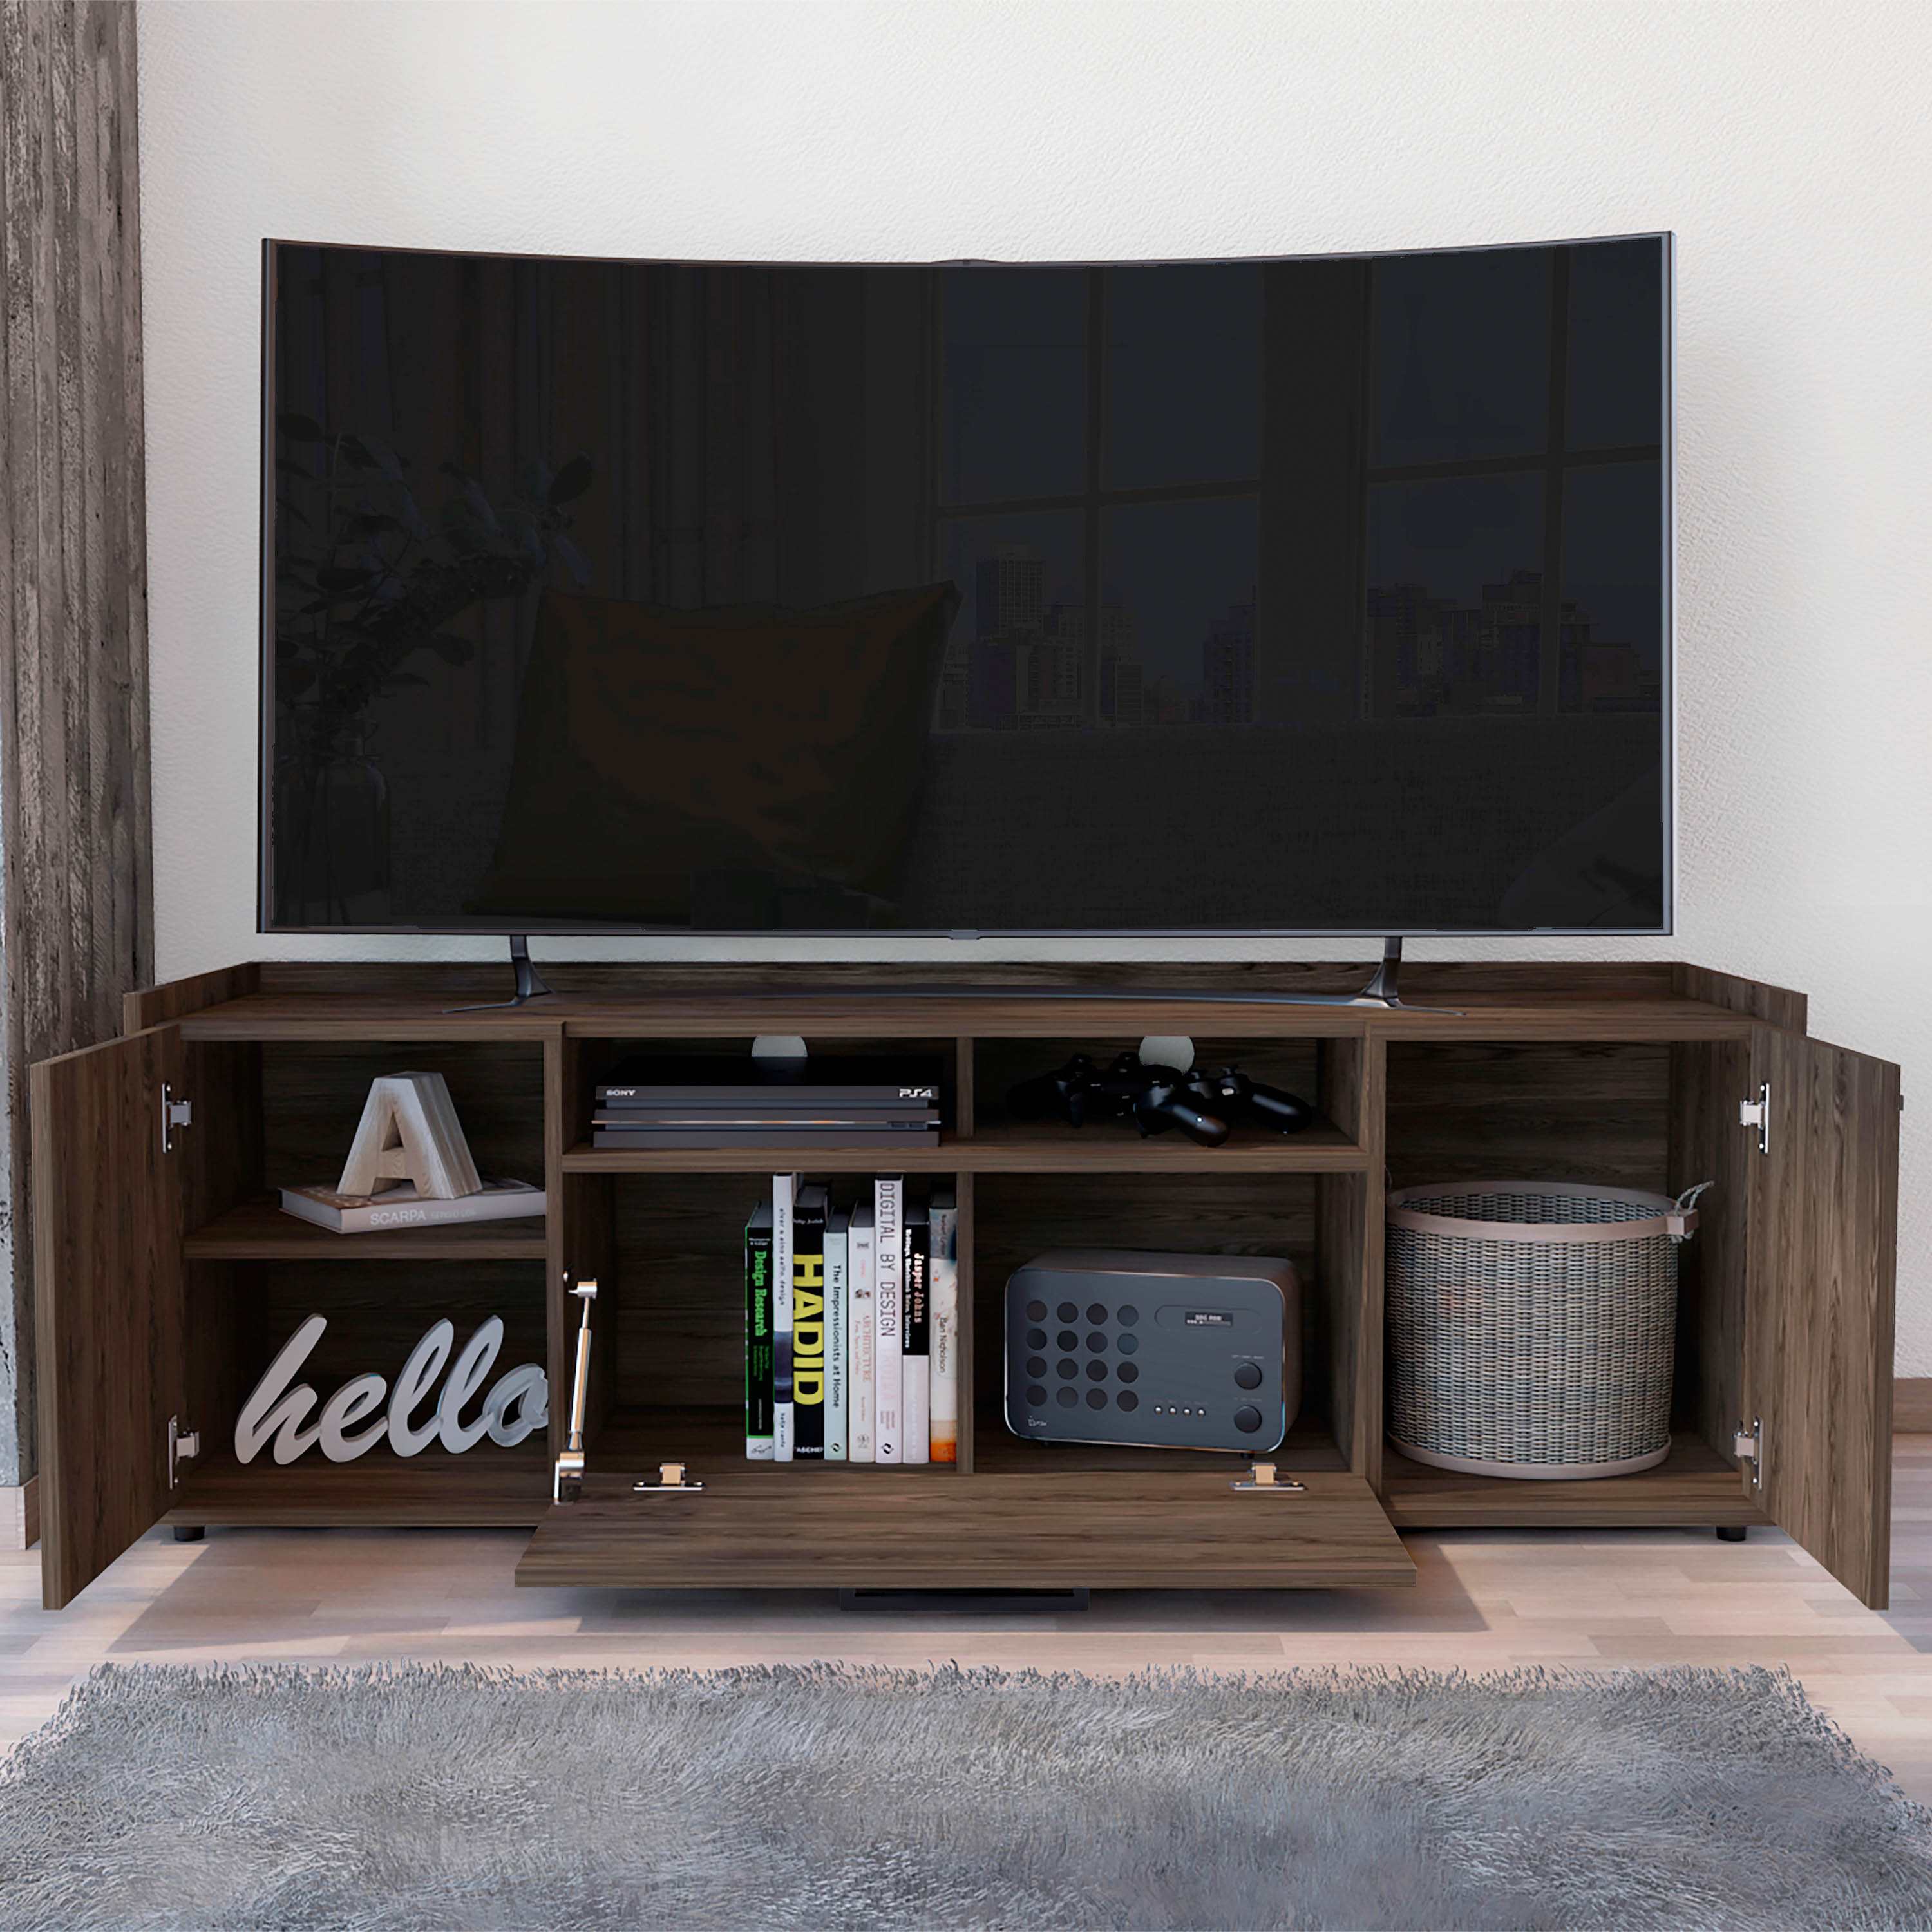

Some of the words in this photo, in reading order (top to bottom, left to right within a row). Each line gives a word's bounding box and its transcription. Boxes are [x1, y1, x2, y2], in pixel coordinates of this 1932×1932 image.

[899, 1088, 932, 1097] PS4
[336, 1078, 455, 1200] A
[370, 1209, 426, 1226] SCARPA
[880, 1182, 895, 1244] DIGITAL
[752, 1251, 767, 1287] Design
[880, 1254, 895, 1271] BY
[911, 1253, 925, 1289] Jasper
[755, 1289, 767, 1336] Research
[831, 1287, 842, 1362] Impressionists
[880, 1282, 896, 1336] DESIGN
[914, 1291, 925, 1323] Johns
[940, 1317, 948, 1333] Ben
[793, 1255, 824, 1405] HADID
[863, 1314, 871, 1382] ARCHITECTURE
[833, 1365, 840, 1375] at
[940, 1335, 948, 1374] Nicholson
[234, 1314, 549, 1465] hello
